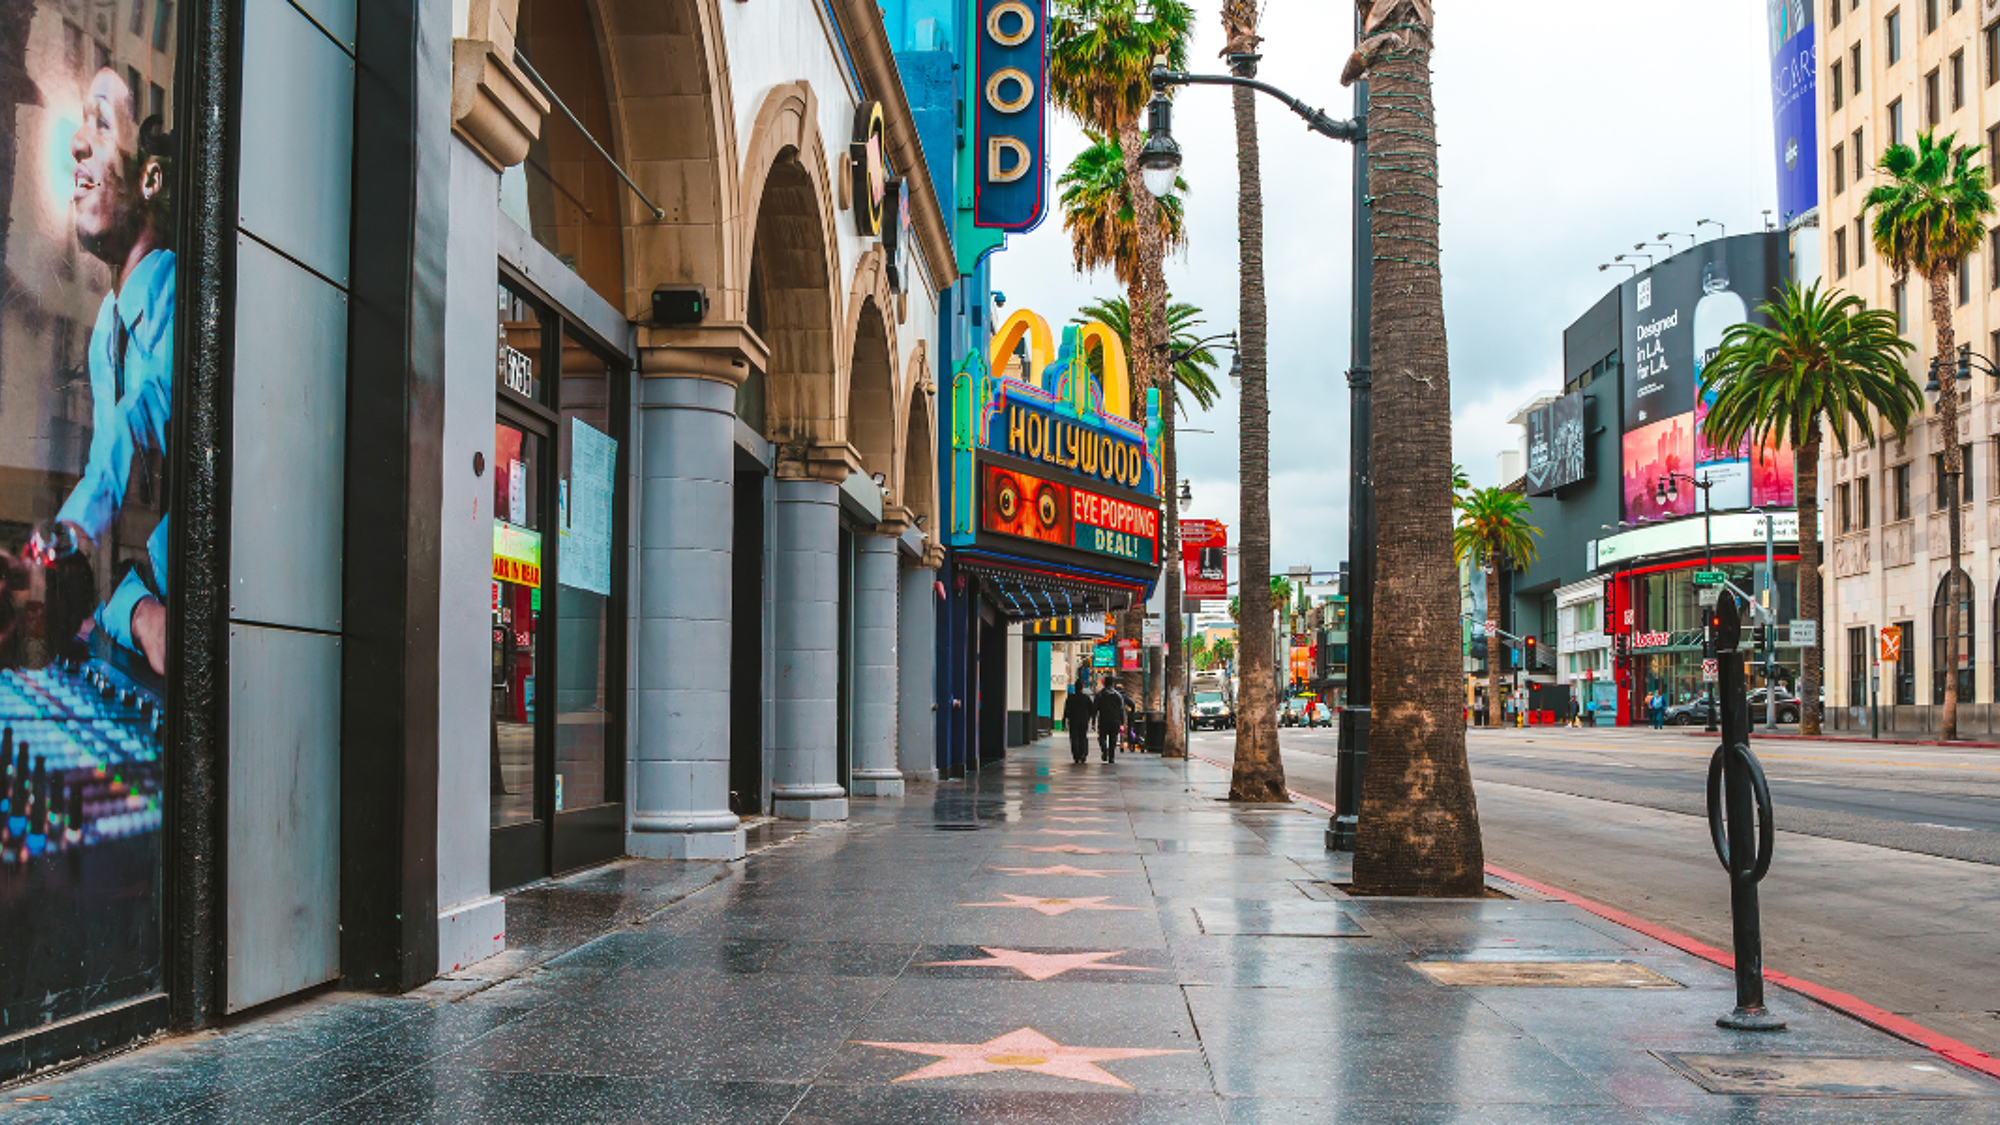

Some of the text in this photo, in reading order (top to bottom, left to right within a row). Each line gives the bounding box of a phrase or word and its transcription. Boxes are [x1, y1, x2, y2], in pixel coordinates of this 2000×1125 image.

[1637, 309, 1678, 342] Designed
[1637, 346, 1646, 363] in
[1637, 362, 1649, 381] for
[1008, 404, 1141, 487] HOLLYWOOD
[1074, 490, 1098, 523] EYE
[1101, 498, 1154, 537] POPPING
[1095, 528, 1138, 558] DEAL!
[493, 556, 509, 578] ARK
[521, 563, 540, 586] REAR
[1634, 629, 1668, 648] Locker
